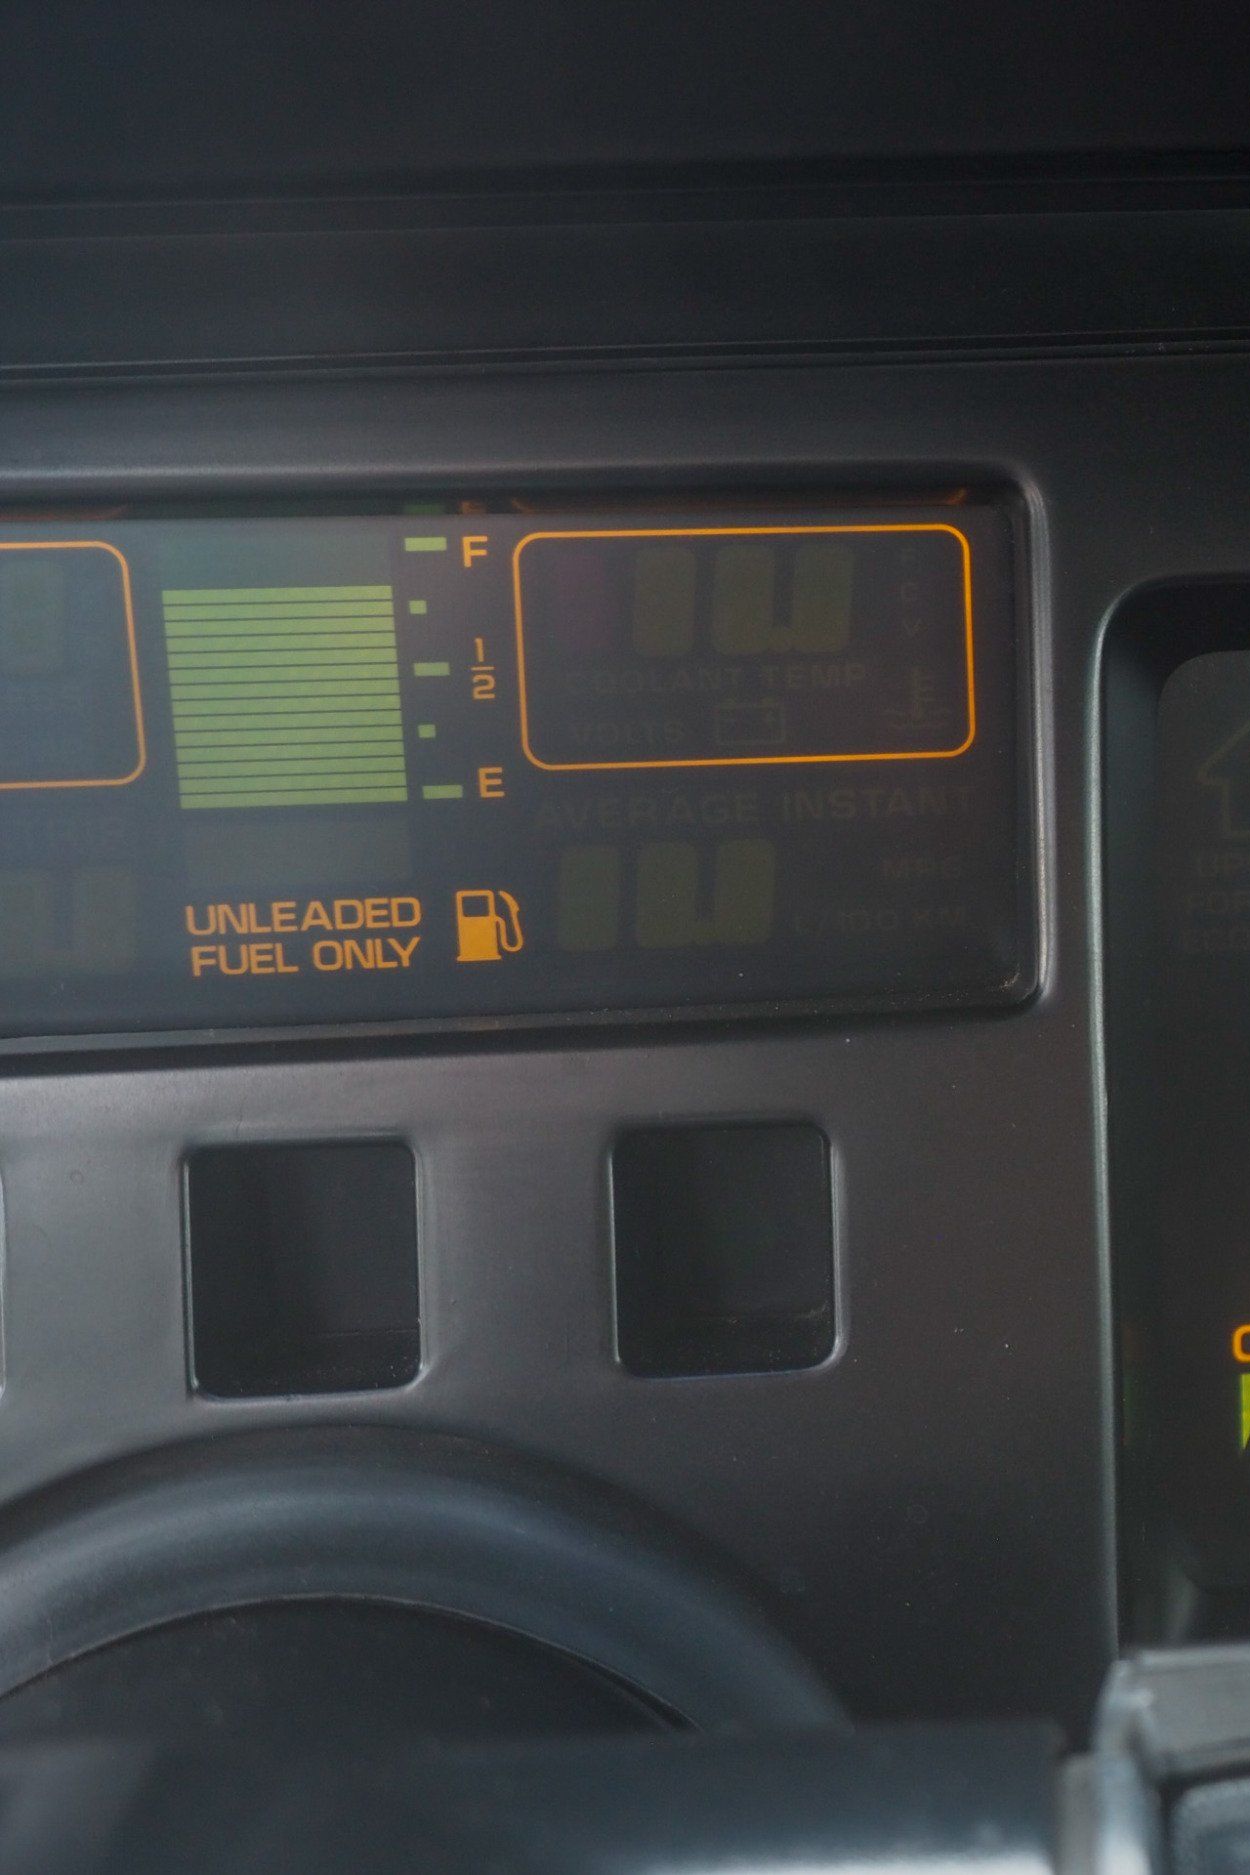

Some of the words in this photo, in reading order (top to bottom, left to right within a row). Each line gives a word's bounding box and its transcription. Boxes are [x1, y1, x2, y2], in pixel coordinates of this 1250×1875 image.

[461, 535, 489, 568] F
[566, 667, 743, 696] COOLANT
[760, 663, 868, 690] TEMP
[478, 766, 504, 798] E
[534, 793, 760, 830] AVERAGE
[781, 784, 974, 821] INSTANT
[186, 897, 422, 935] UNLEADED
[191, 943, 299, 977] FUEL
[313, 936, 420, 970] ONLY
